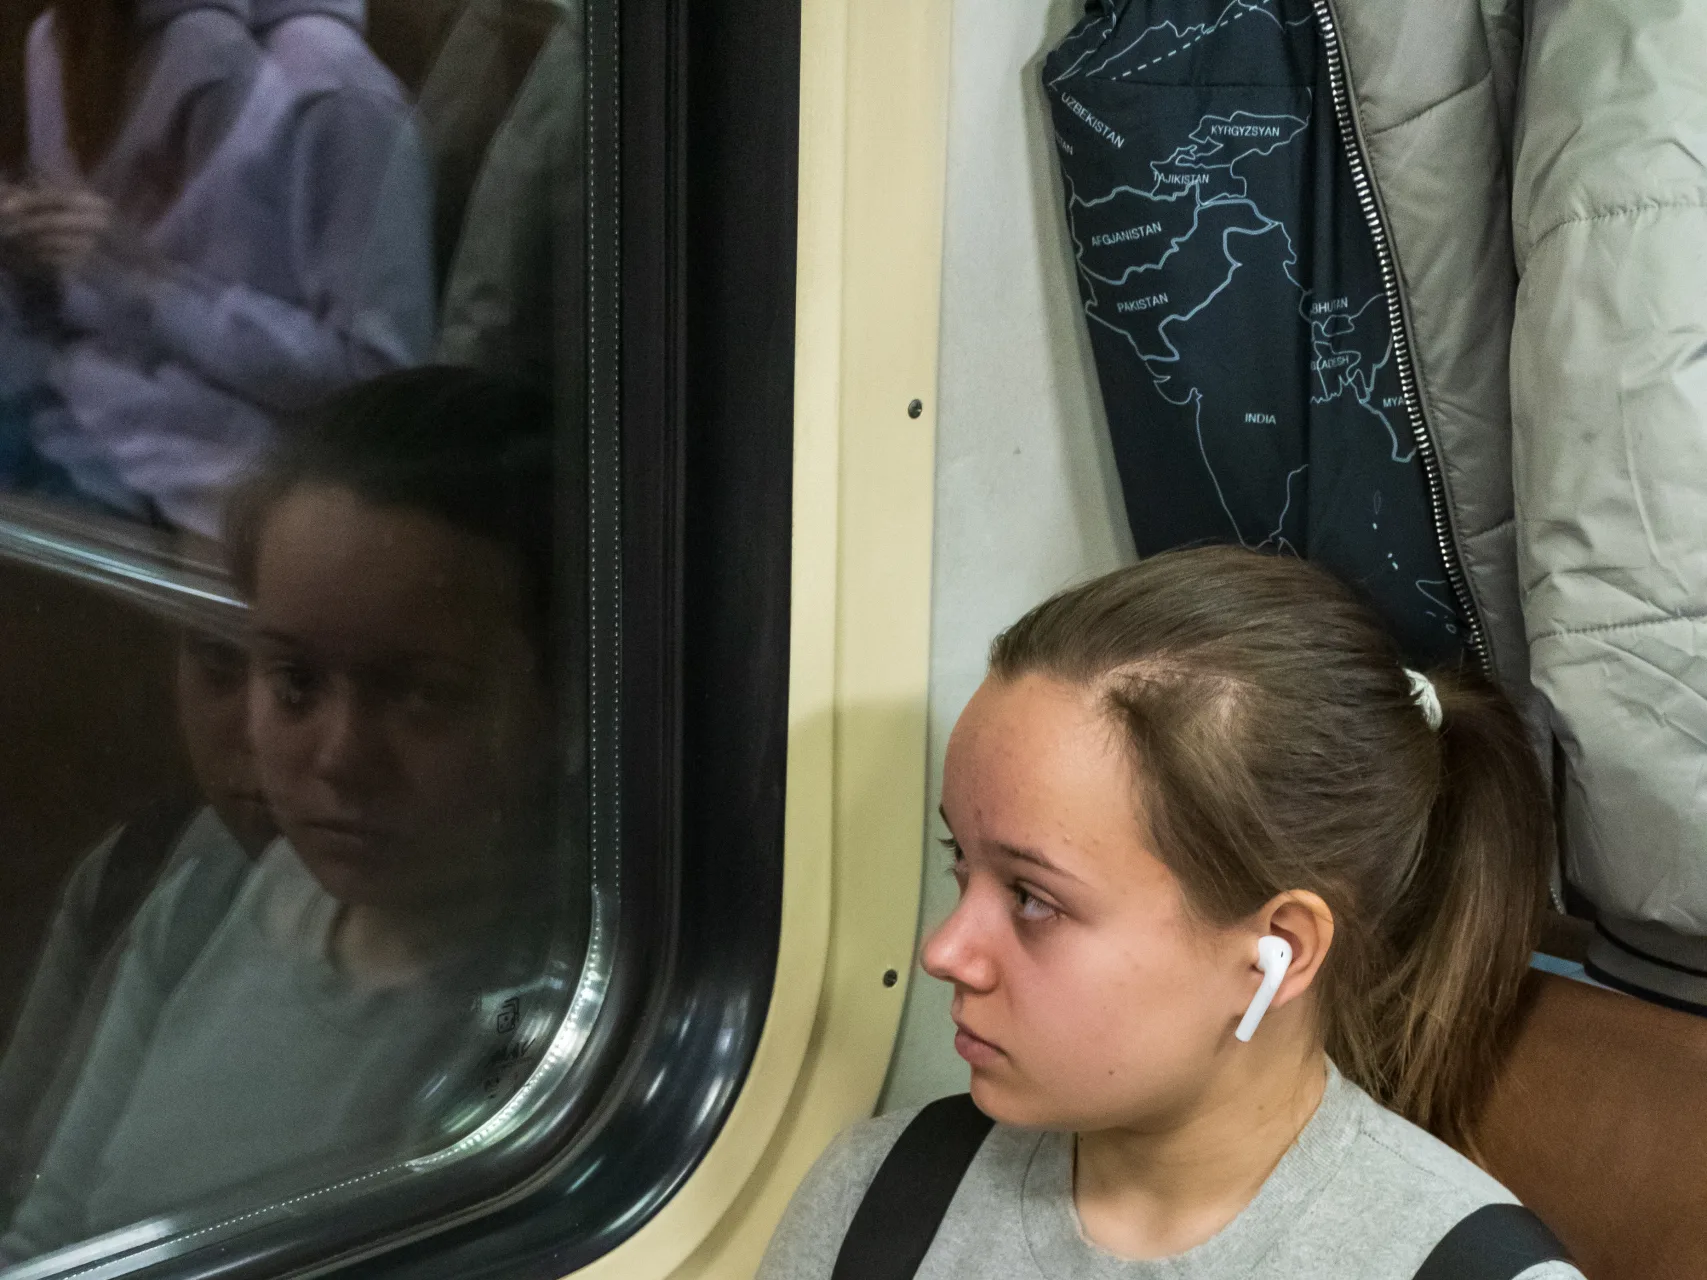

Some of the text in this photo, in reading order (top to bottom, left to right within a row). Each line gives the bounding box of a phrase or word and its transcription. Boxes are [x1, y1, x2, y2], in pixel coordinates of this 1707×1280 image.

[1061, 92, 1125, 148] UZBEKISTAN
[1153, 171, 1209, 185] TAJIKISTAN
[1116, 292, 1169, 313] PAKISTAN
[1311, 296, 1348, 314] BHUTAN
[1245, 412, 1277, 425] INDIA
